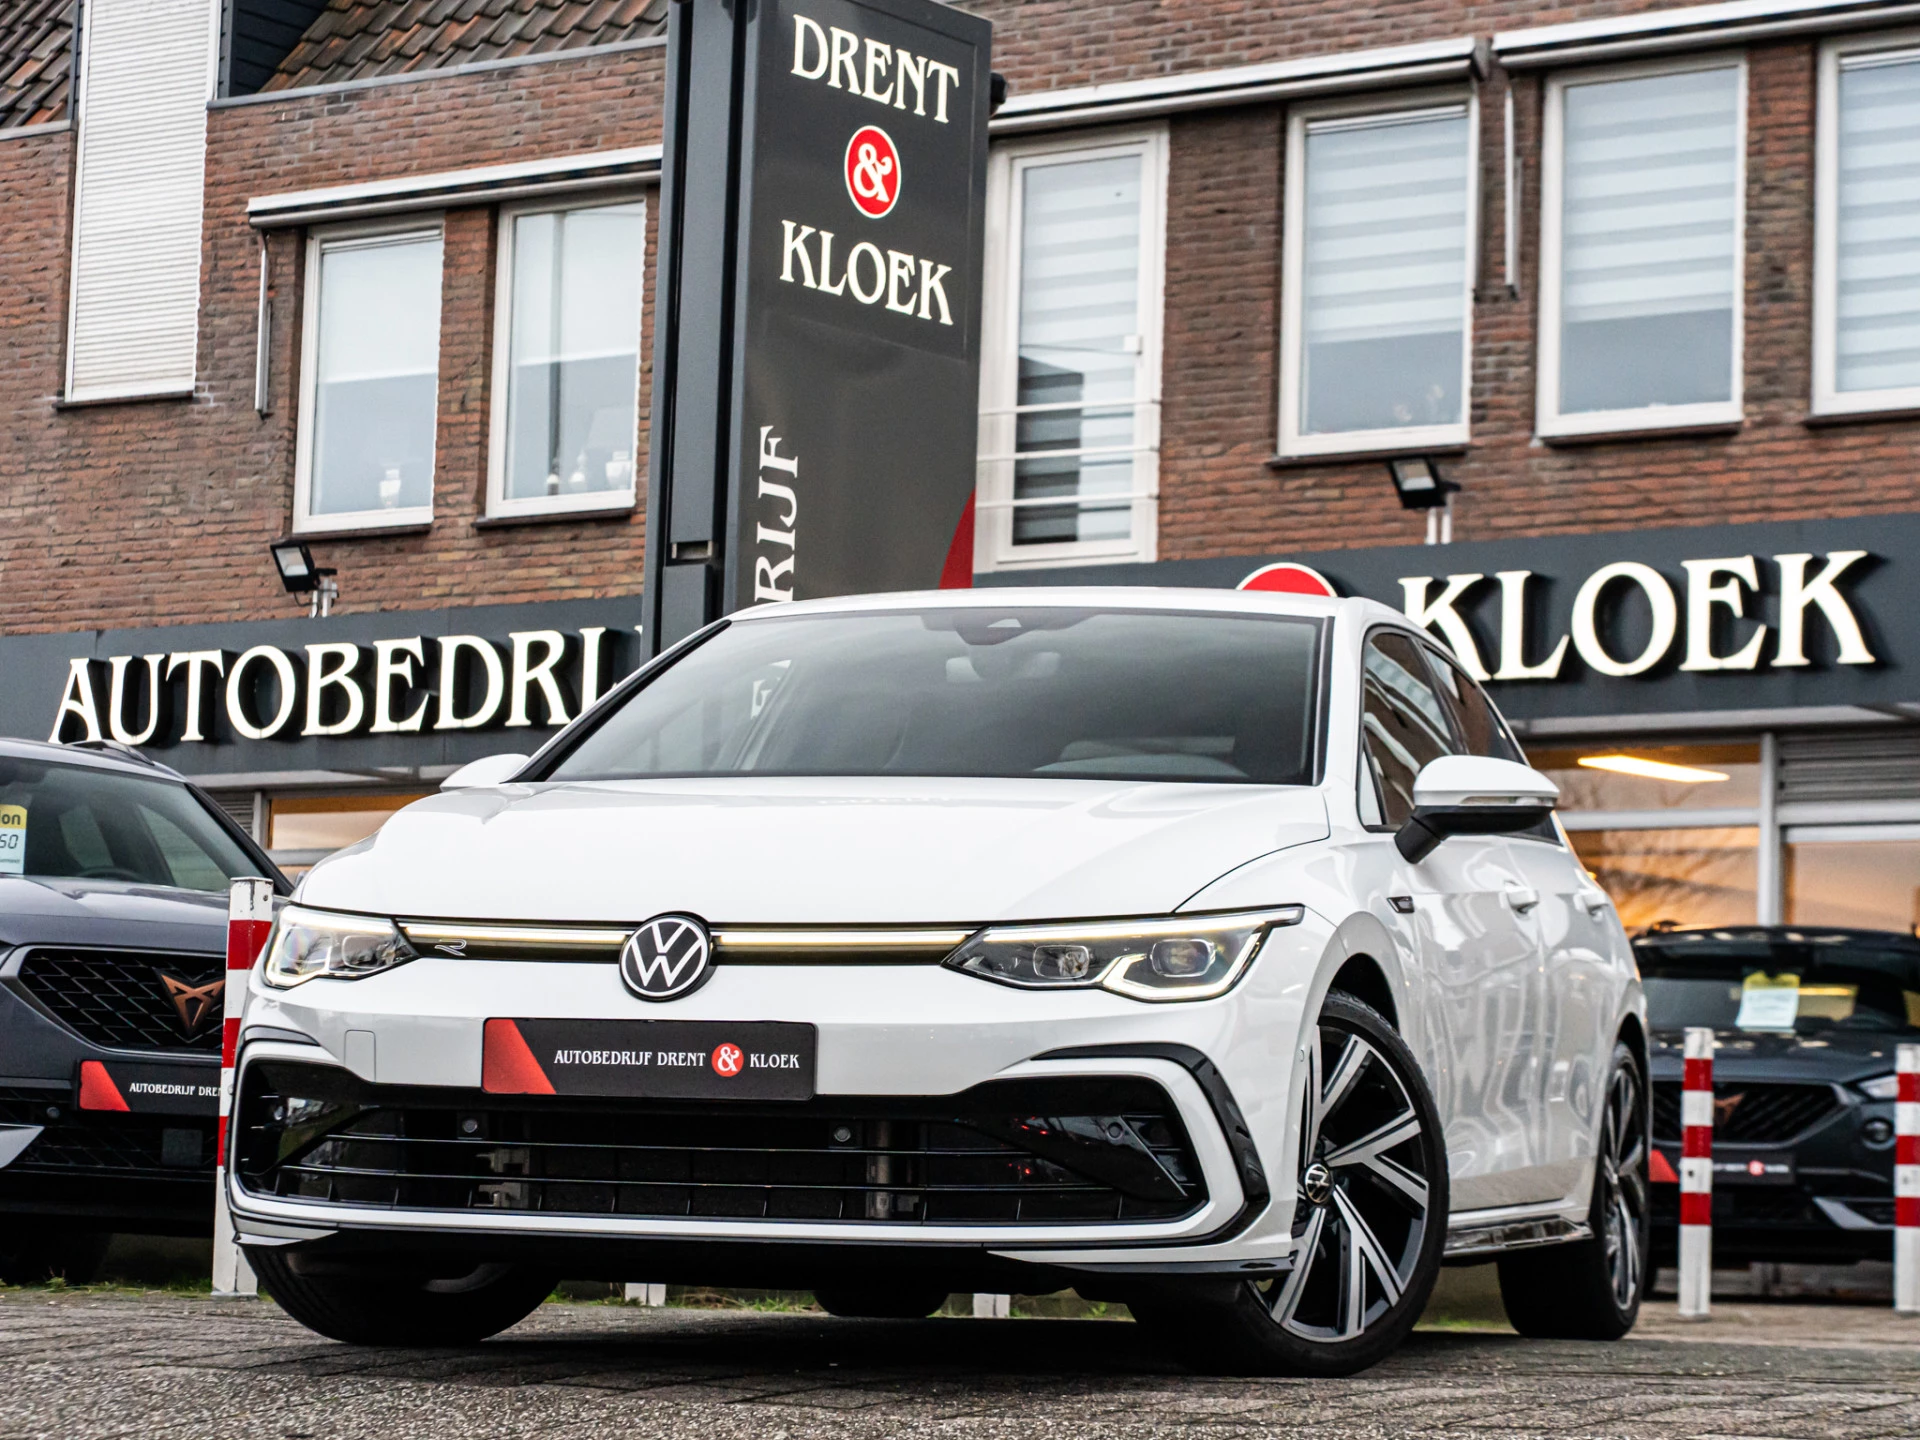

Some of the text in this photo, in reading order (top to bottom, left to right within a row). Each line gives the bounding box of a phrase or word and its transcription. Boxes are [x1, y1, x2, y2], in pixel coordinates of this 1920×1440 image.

[790, 13, 960, 124] DRENT
[853, 142, 893, 203] &
[779, 219, 954, 326] KLOEK
[1398, 550, 1876, 682] KLOEK
[47, 625, 643, 746] AUTOBEDRI
[129, 1082, 196, 1096] AUTOBEDRIJF
[553, 1046, 800, 1072] AUTOBEDRIJF DRENT & KLOEK
